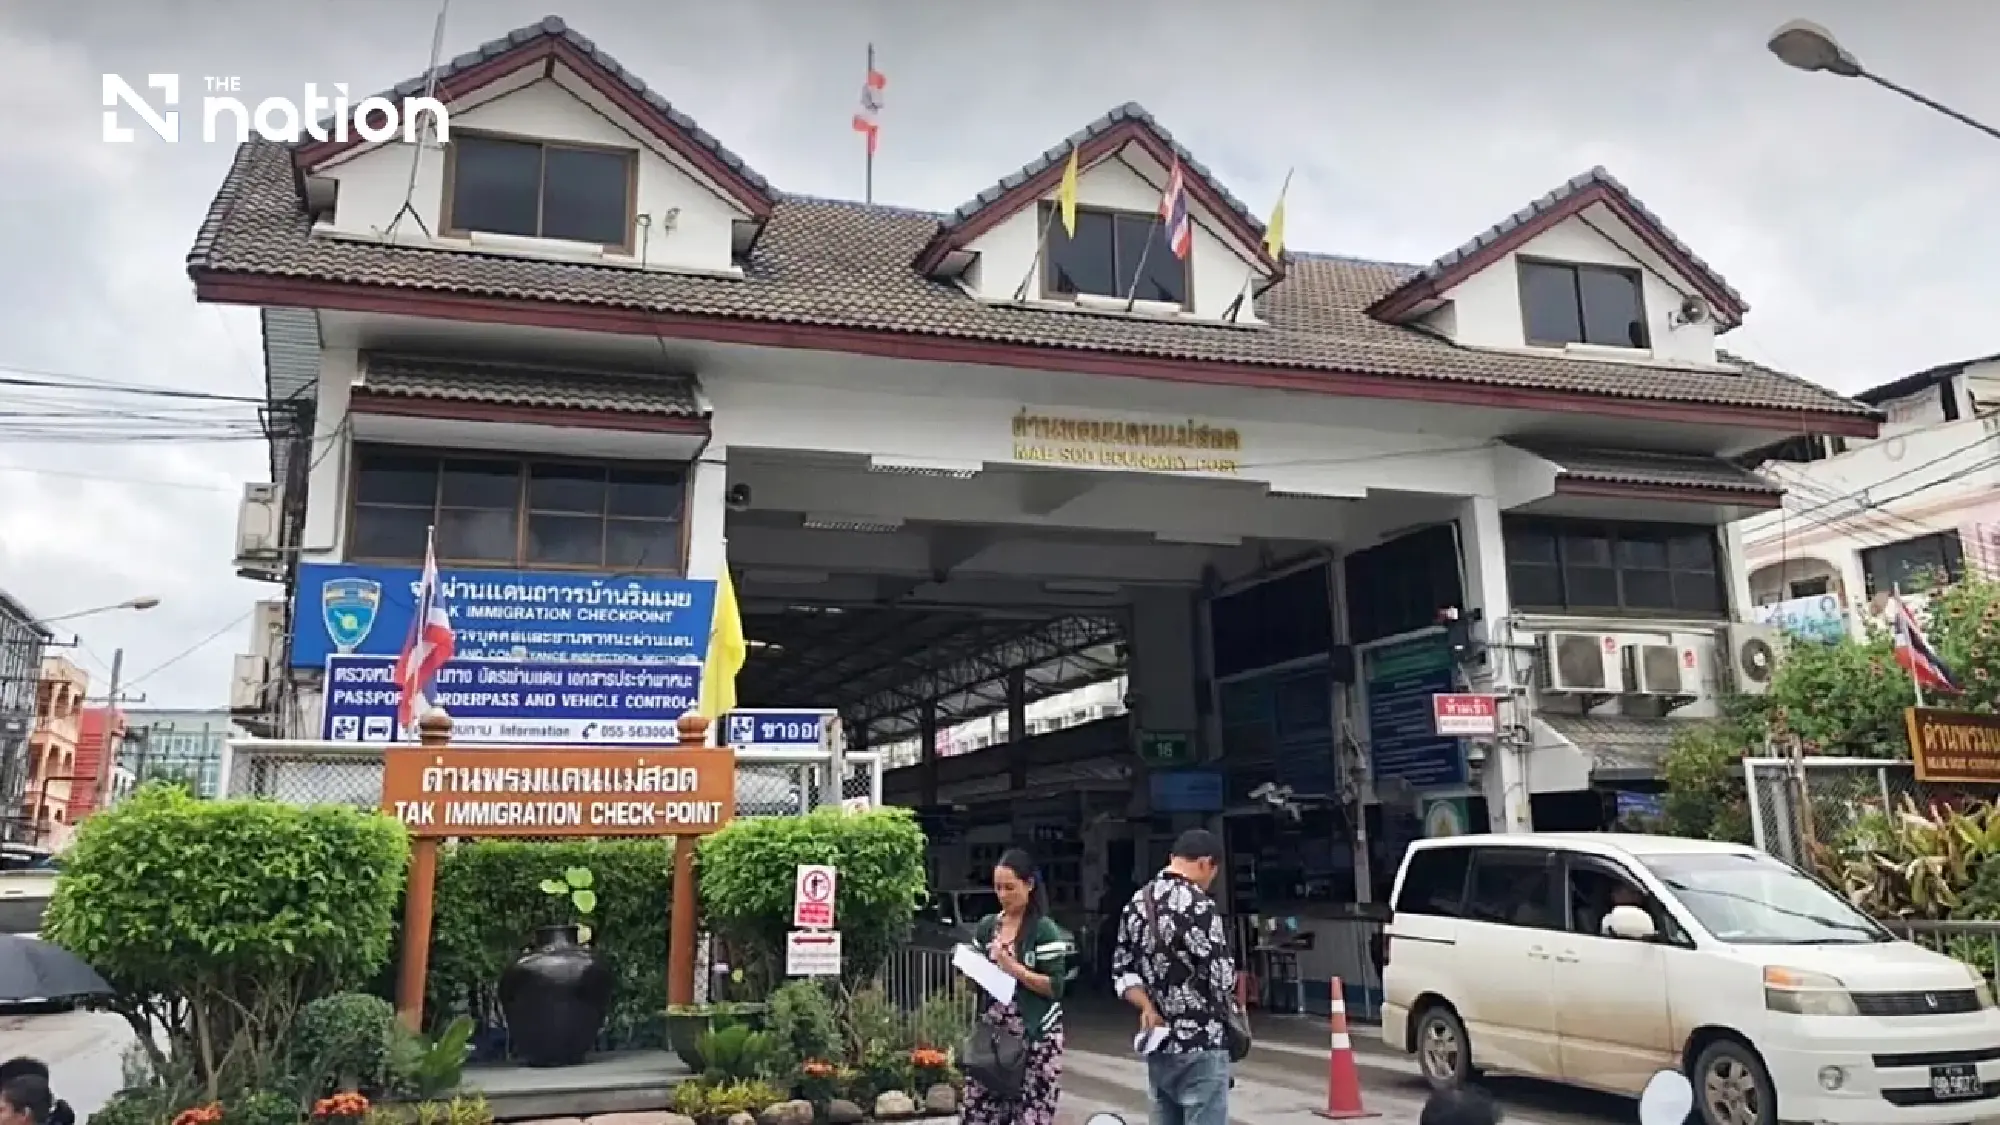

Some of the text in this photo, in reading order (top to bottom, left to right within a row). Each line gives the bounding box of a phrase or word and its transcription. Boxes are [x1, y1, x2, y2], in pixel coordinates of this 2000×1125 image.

[466, 605, 571, 621] IMMIGRATION
[577, 607, 674, 623] CHECKPOINT
[525, 693, 556, 707] AND
[562, 693, 619, 709] VEHICLE
[625, 694, 688, 709] CONTROL
[422, 756, 698, 793] ด่านพรมแดนแม่สอด
[395, 801, 723, 826] TAK IMMIGRATION CHECK-POINT
